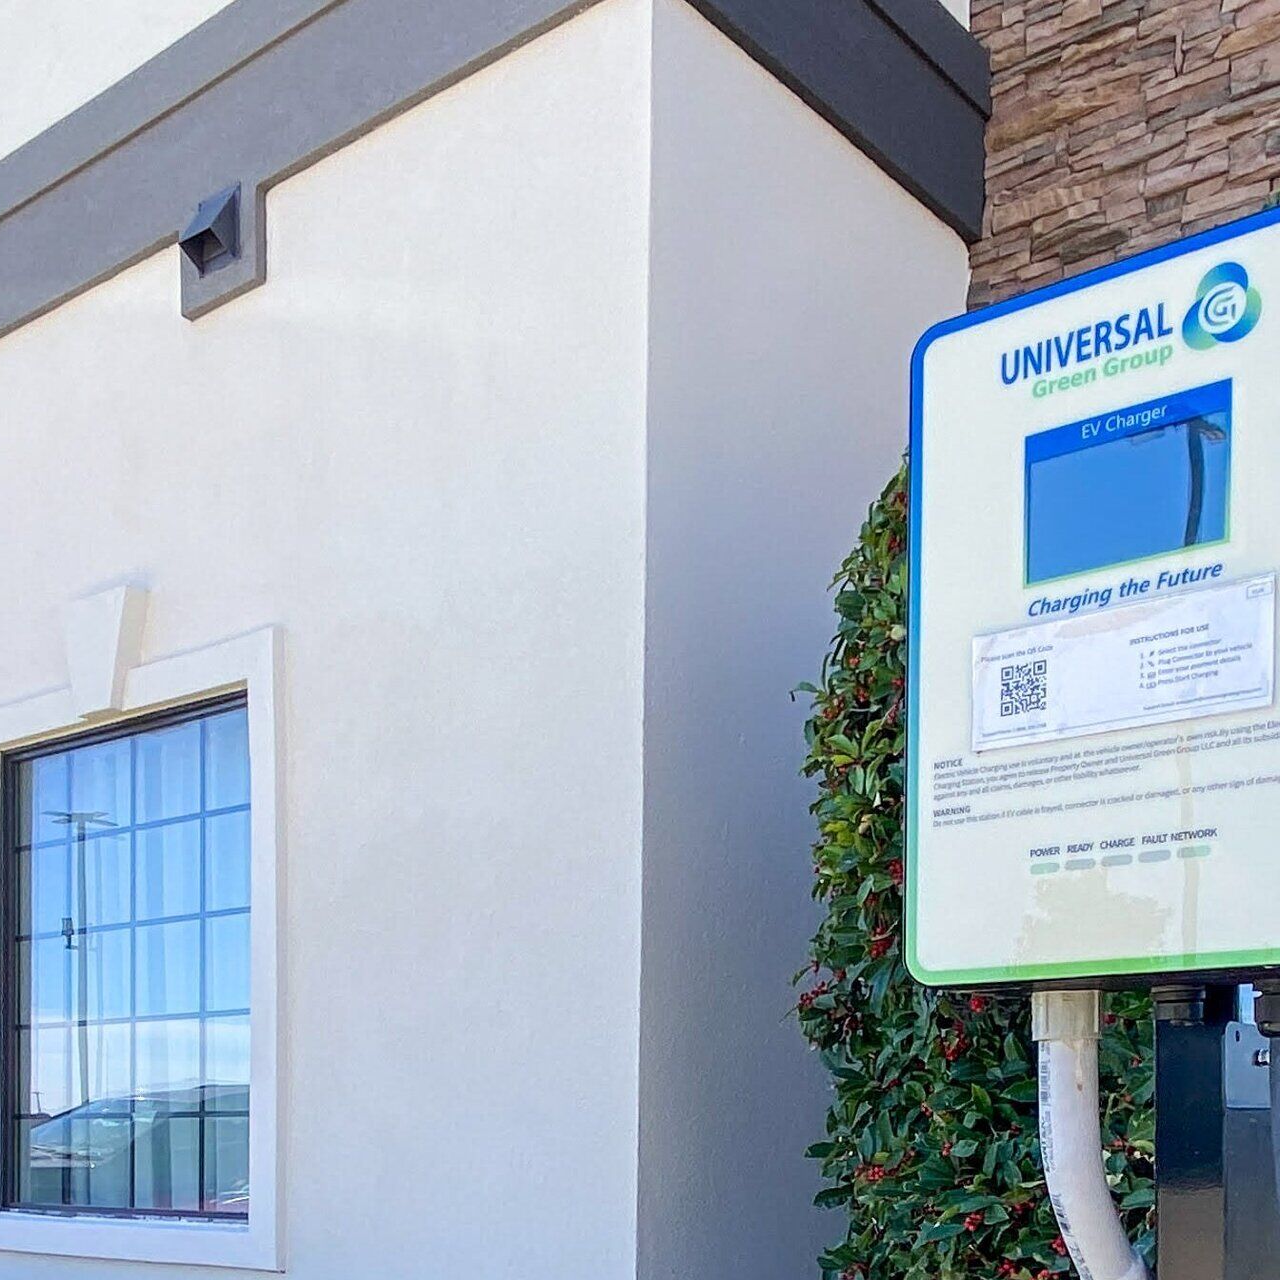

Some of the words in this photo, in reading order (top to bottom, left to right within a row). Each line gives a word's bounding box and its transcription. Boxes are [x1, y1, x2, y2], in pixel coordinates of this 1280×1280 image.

[1001, 302, 1173, 385] UNIVERSAL
[1032, 367, 1097, 398] Green
[1102, 344, 1173, 377] Group
[1081, 420, 1102, 439] EV
[1105, 404, 1168, 432] Charger
[1028, 586, 1112, 617] Charging
[1119, 578, 1150, 598] the
[1156, 563, 1223, 590] Future
[933, 758, 963, 770] NOTICE
[932, 805, 970, 818] WARNING
[1030, 846, 1060, 858] POWER
[1067, 842, 1095, 854] READY
[1100, 837, 1135, 850] CHARGE
[1141, 833, 1169, 845] FAULT
[1170, 828, 1218, 841] NETWORK
